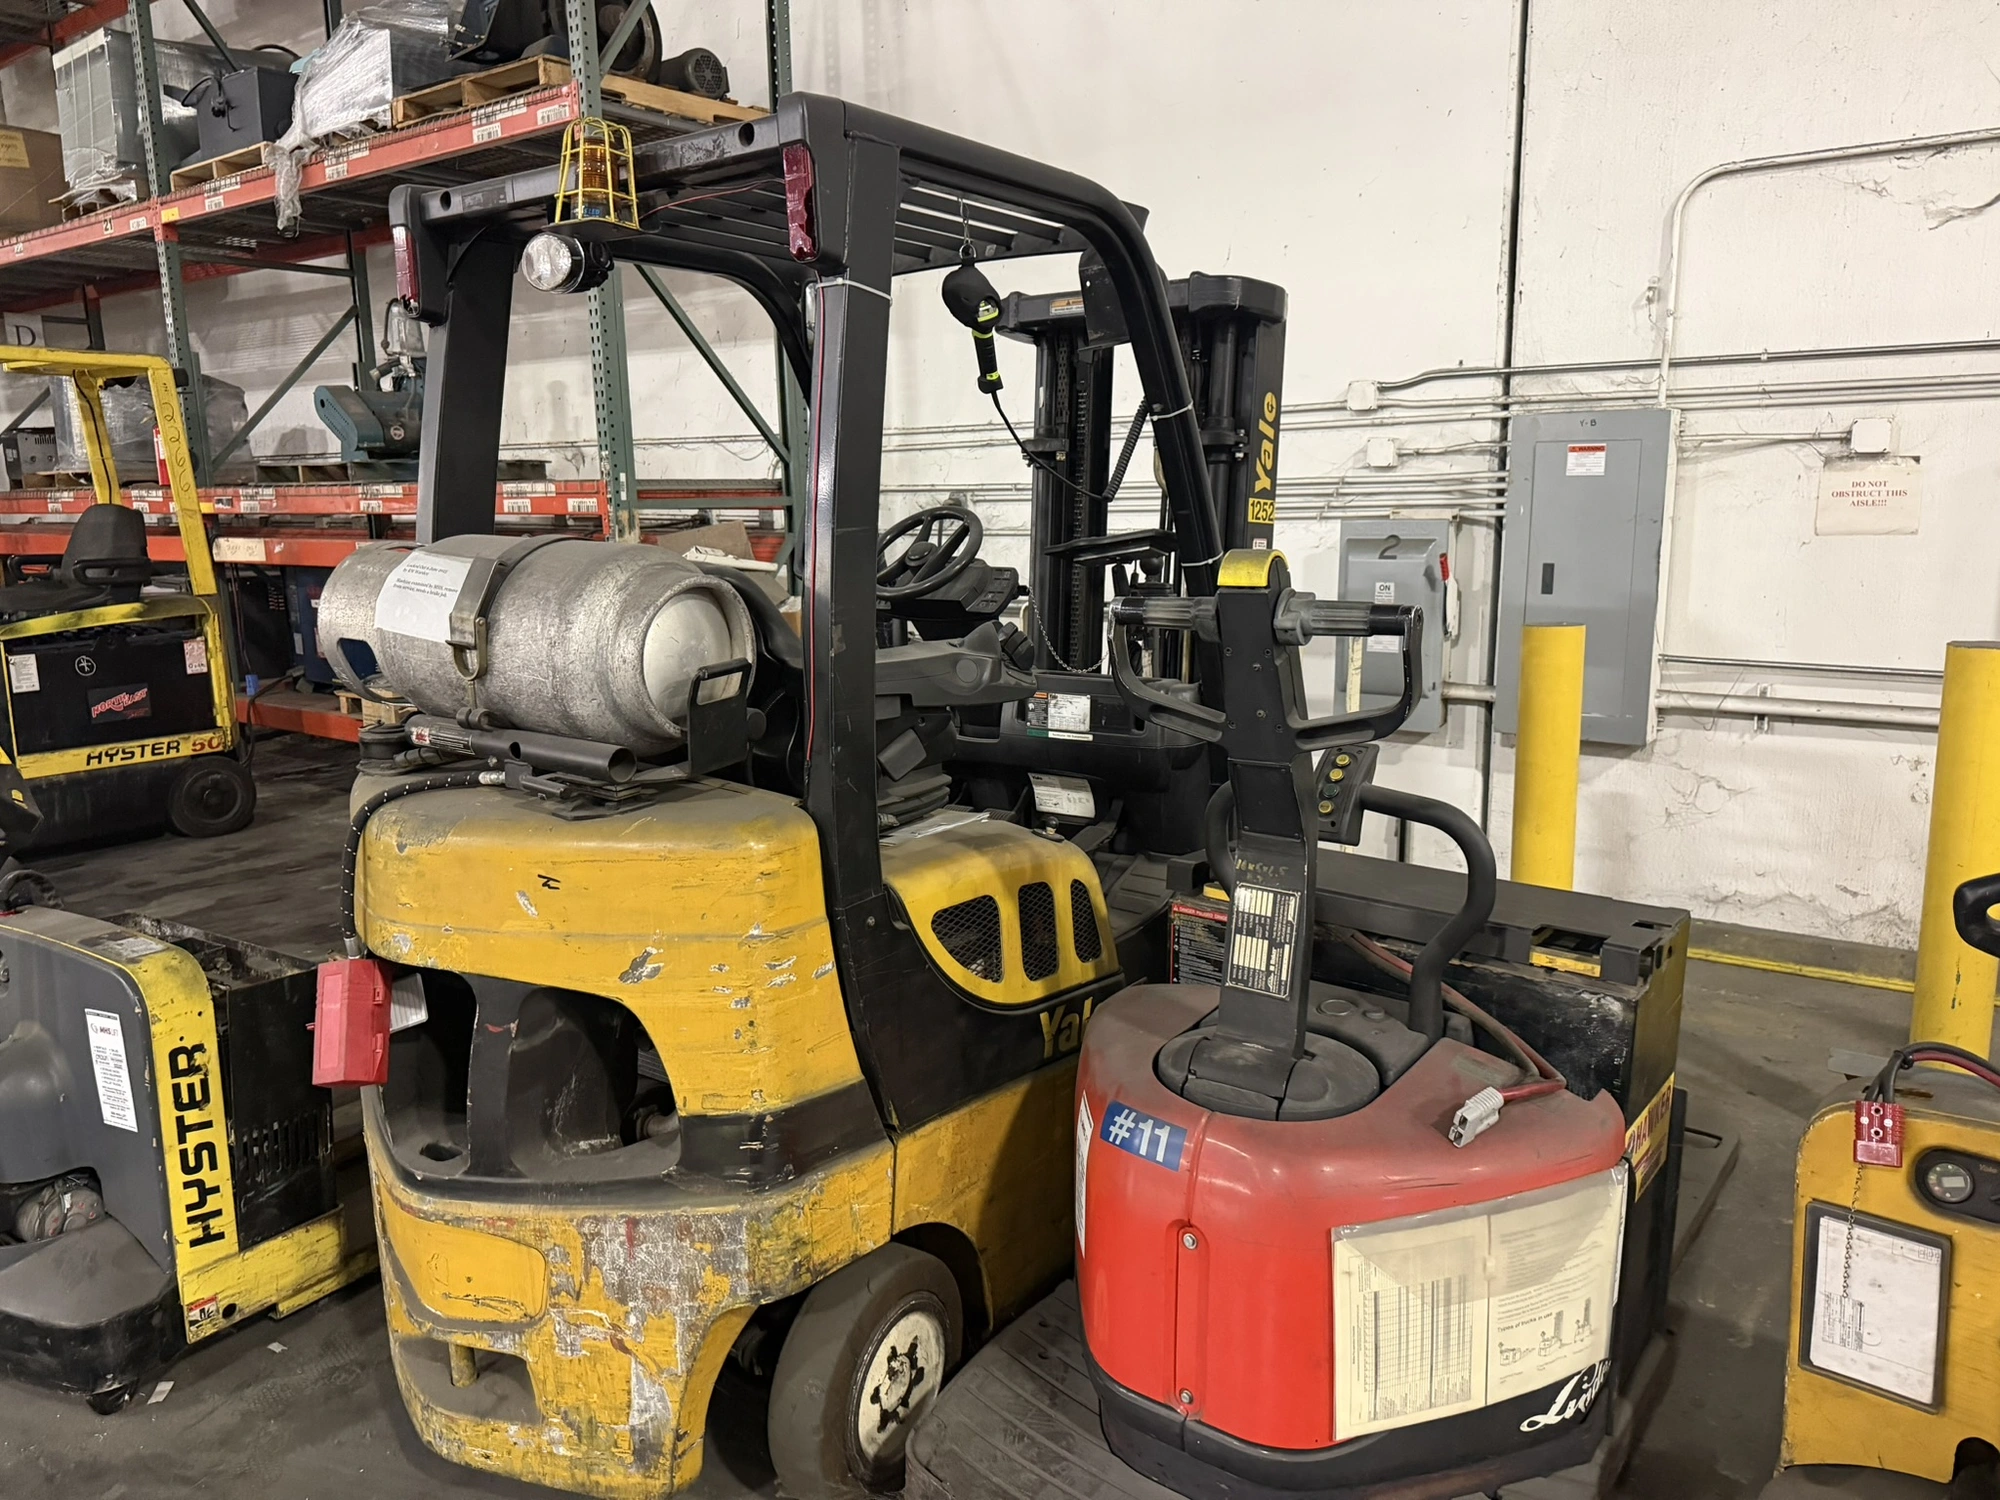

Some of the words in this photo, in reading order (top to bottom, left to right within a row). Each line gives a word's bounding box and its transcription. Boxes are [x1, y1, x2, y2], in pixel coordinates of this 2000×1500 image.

[104, 218, 112, 232] 21
[14, 325, 36, 346] D
[1254, 392, 1276, 493] Yale
[1831, 490, 1883, 498] OBSTRUCT
[1852, 480, 1866, 488] DO
[1868, 480, 1888, 488] NOT
[1250, 500, 1274, 522] 1252
[1378, 534, 1401, 560] 2
[1379, 584, 1391, 592] ON
[86, 740, 180, 766] HYSTER
[191, 736, 224, 752] 50
[1040, 996, 1093, 1059] Yal
[1632, 1085, 1672, 1154] HAWKER
[168, 1043, 226, 1248] HYSTER
[1108, 1108, 1170, 1162] #11
[1980, 1164, 1998, 1174] Yale
[1498, 1322, 1515, 1332] Types
[1521, 1316, 1538, 1326] trucks
[1543, 1310, 1553, 1318] use
